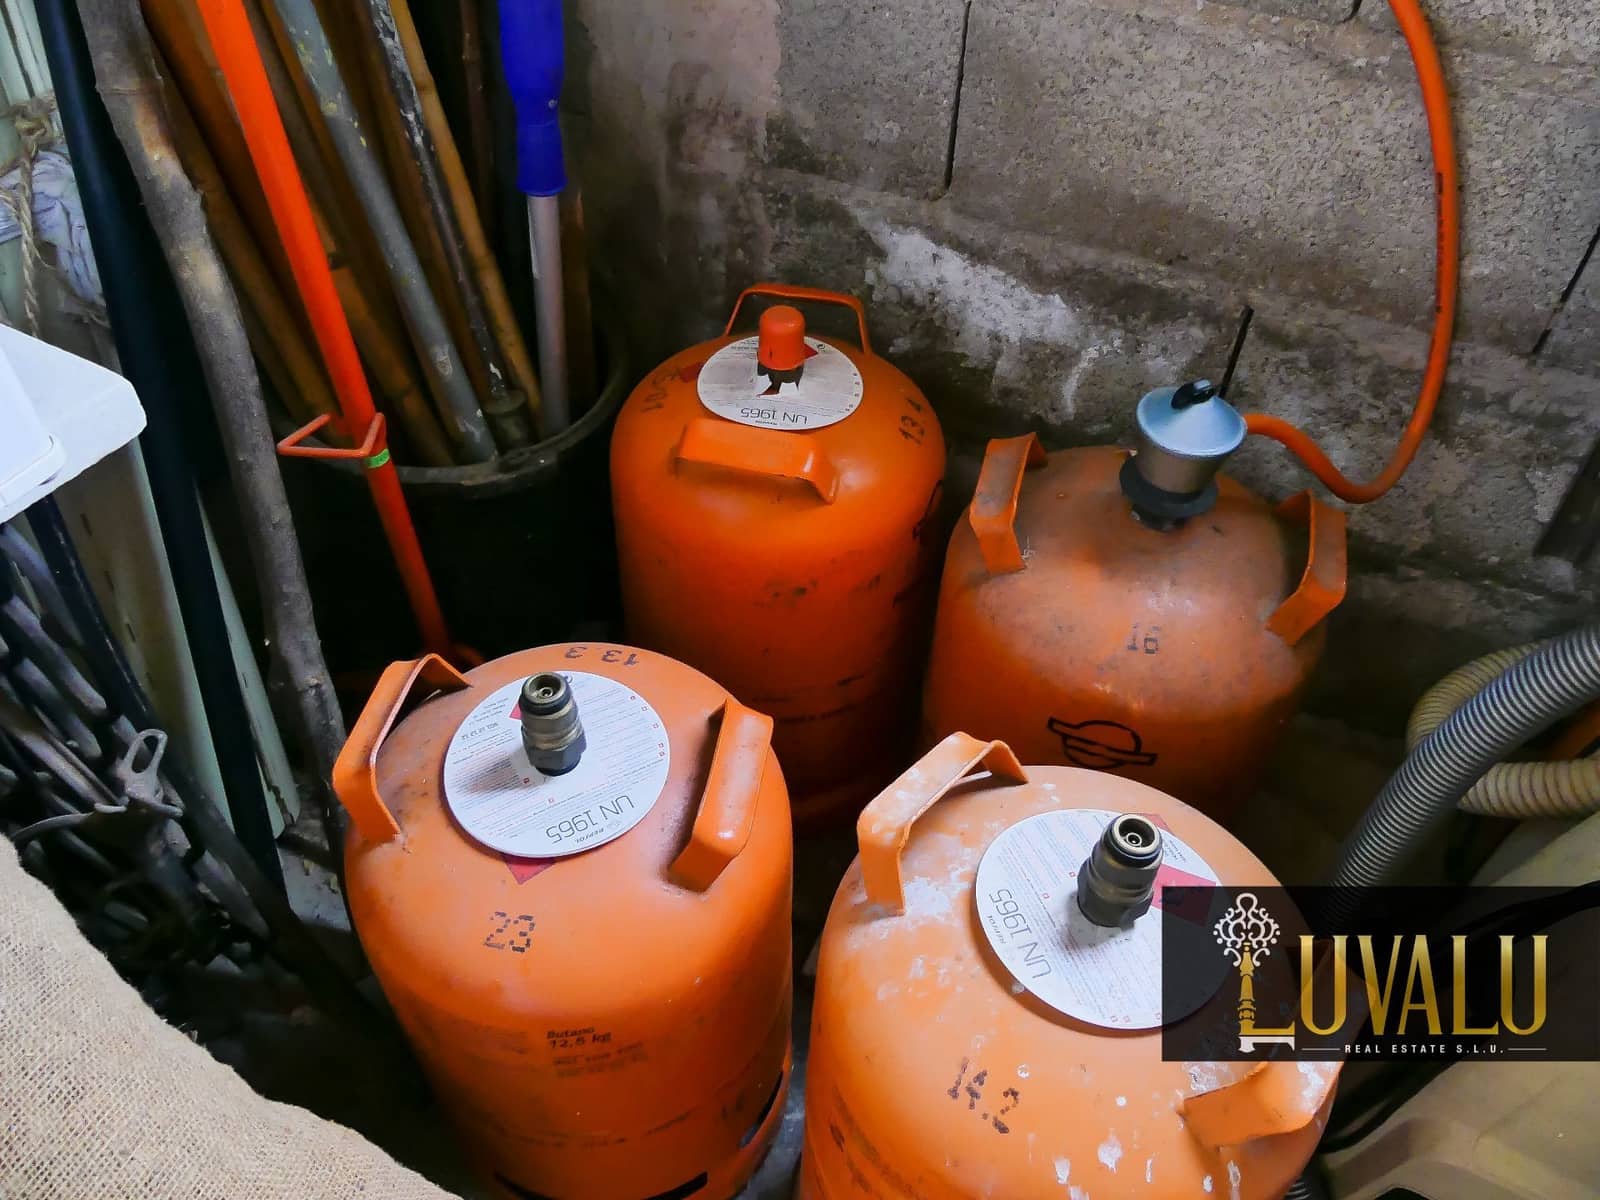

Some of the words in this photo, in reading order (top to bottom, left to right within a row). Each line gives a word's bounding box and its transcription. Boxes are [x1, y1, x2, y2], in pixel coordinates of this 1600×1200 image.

[740, 407, 777, 420] 1965
[782, 411, 808, 425] UN
[1127, 623, 1161, 654] 16
[599, 794, 635, 821] UN
[545, 809, 598, 844] 1965
[988, 888, 1032, 939] 1965
[484, 911, 535, 952] 23
[1017, 940, 1052, 979] UN
[546, 1026, 595, 1040] Butano
[592, 1032, 611, 1043] kg
